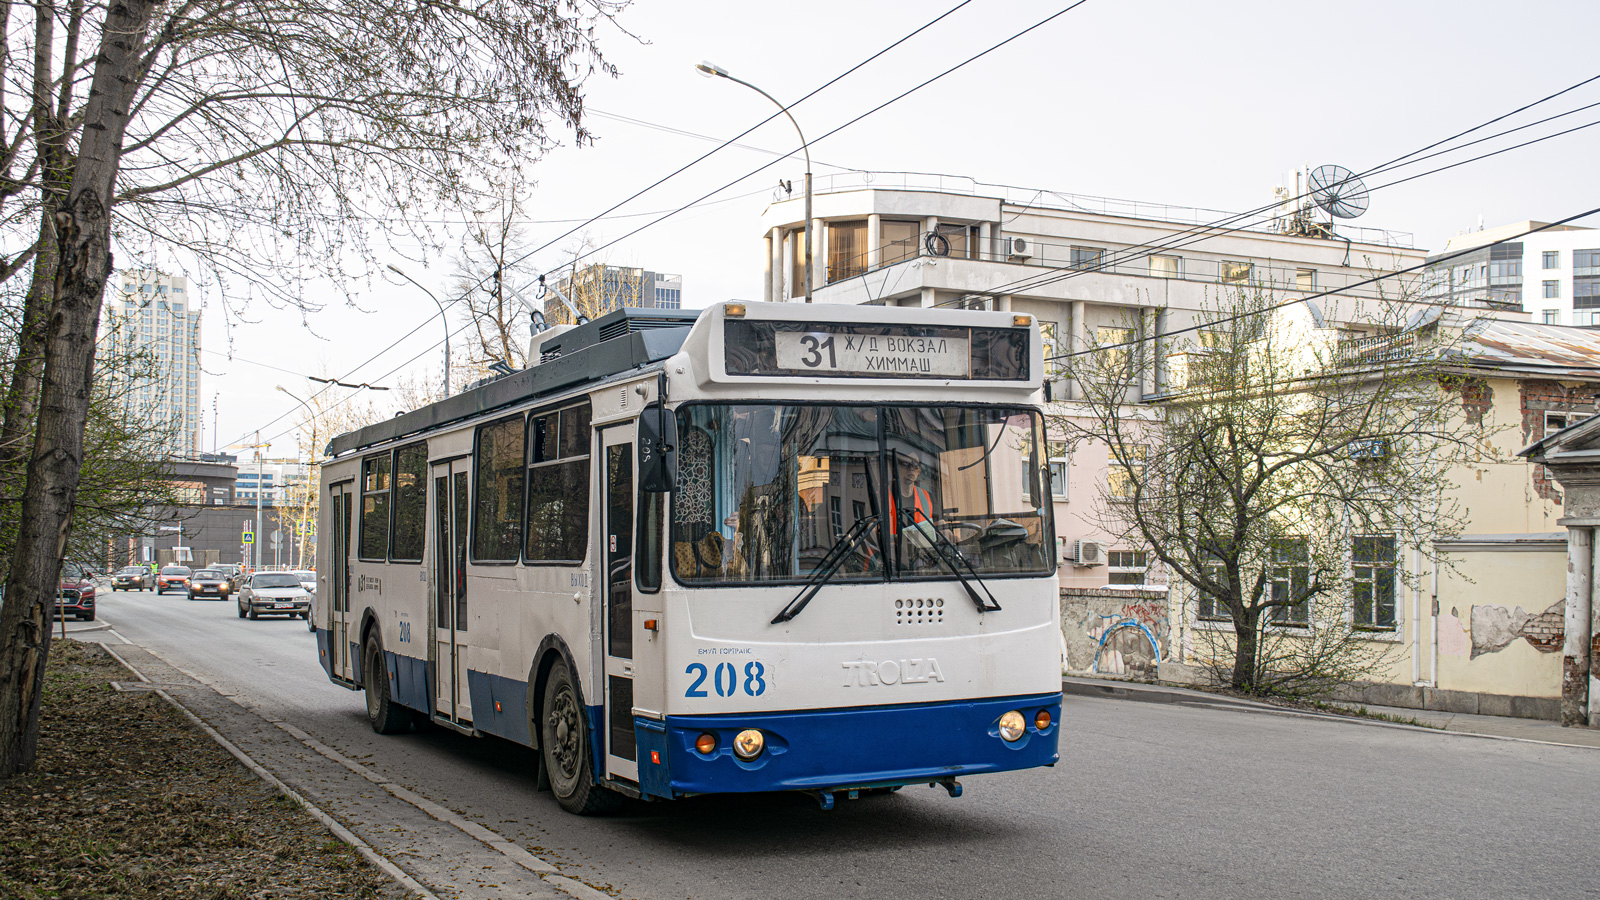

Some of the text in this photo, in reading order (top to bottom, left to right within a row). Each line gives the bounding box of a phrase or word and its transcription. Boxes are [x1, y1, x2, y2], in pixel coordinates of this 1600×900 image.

[800, 335, 948, 369] 31 Ж/Д ВОКЗАЛ
[865, 356, 931, 373] ХИММАШ
[641, 437, 652, 463] 208
[399, 620, 411, 643] 208
[684, 660, 767, 698] 208
[841, 657, 945, 687] TROLZA
